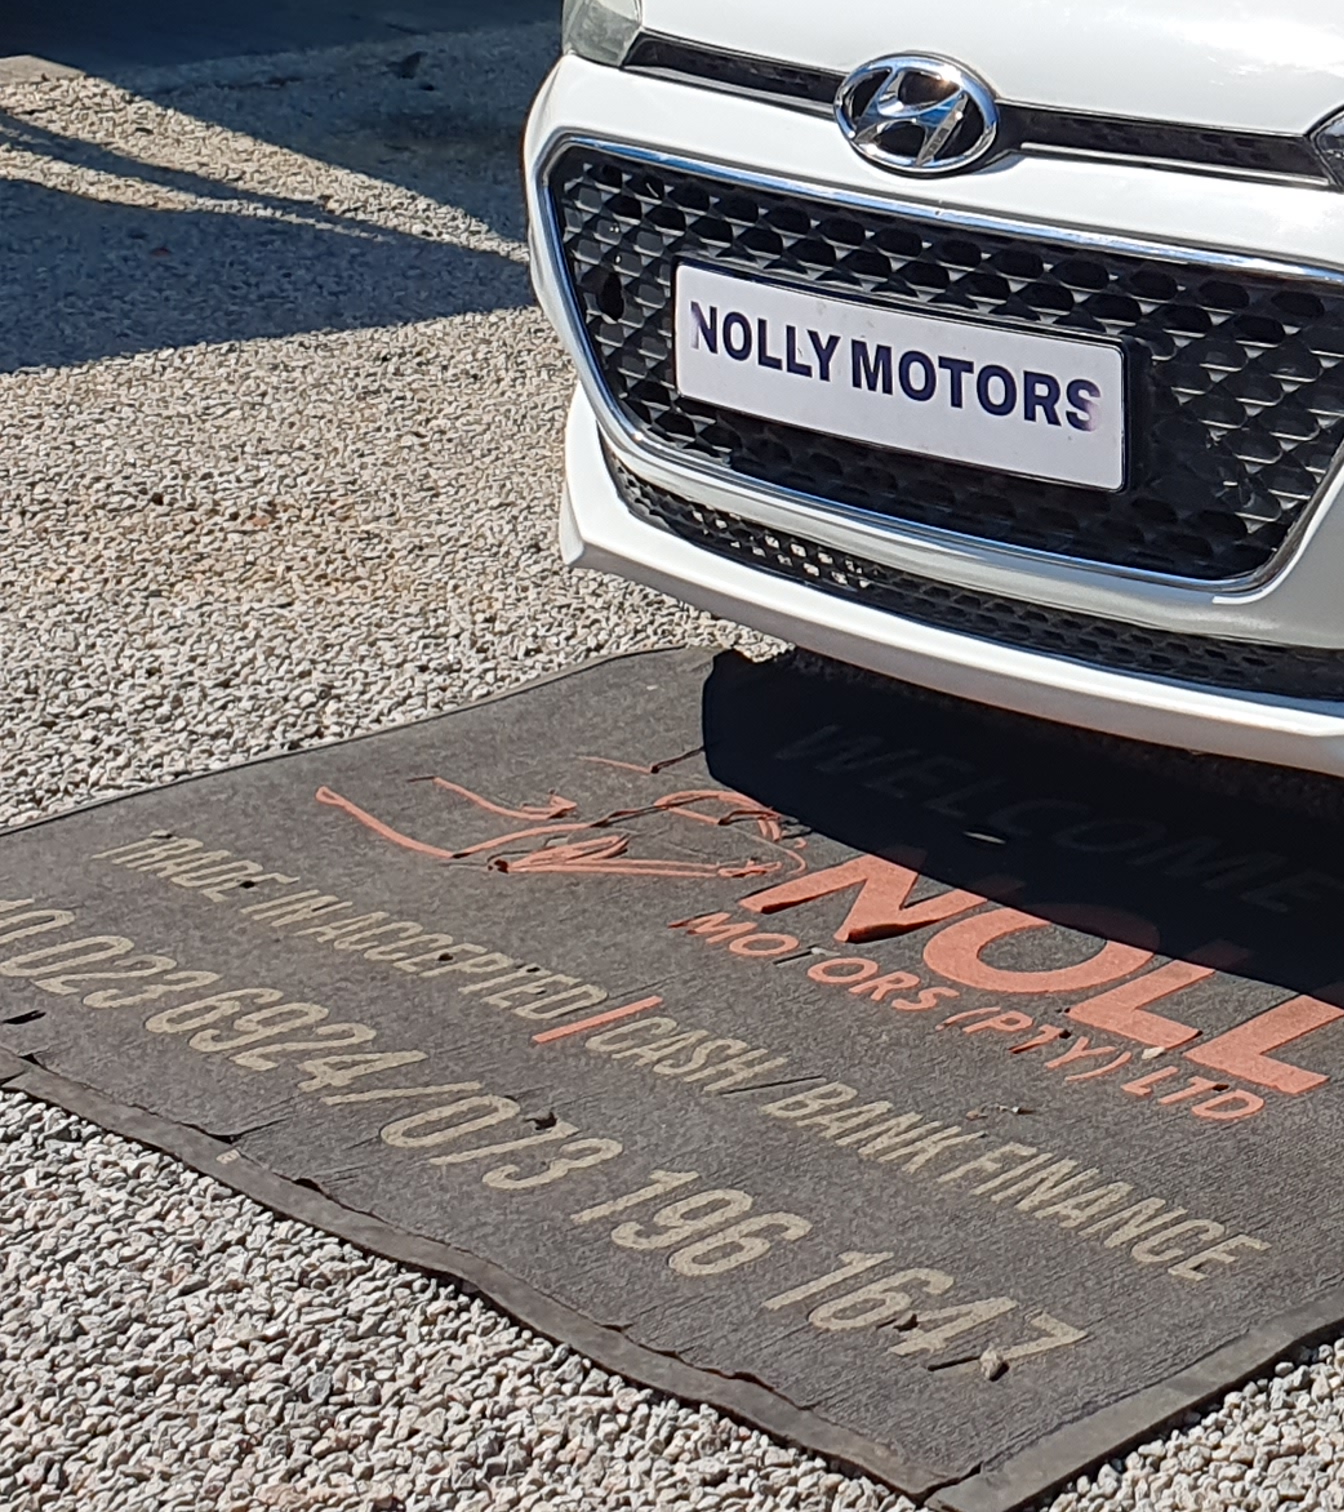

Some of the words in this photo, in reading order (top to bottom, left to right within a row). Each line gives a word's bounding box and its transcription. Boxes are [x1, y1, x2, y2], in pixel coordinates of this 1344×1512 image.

[689, 300, 841, 382] NOLLY
[850, 338, 1101, 432] MOTORS
[92, 830, 300, 903] TRADE
[239, 888, 353, 927] IN
[296, 910, 609, 1020] ACCEPTED
[936, 1140, 1273, 1282] FINANCE
[1121, 1066, 1264, 1120] LTD
[570, 1170, 813, 1278] 196
[760, 1250, 1091, 1374] 1647
